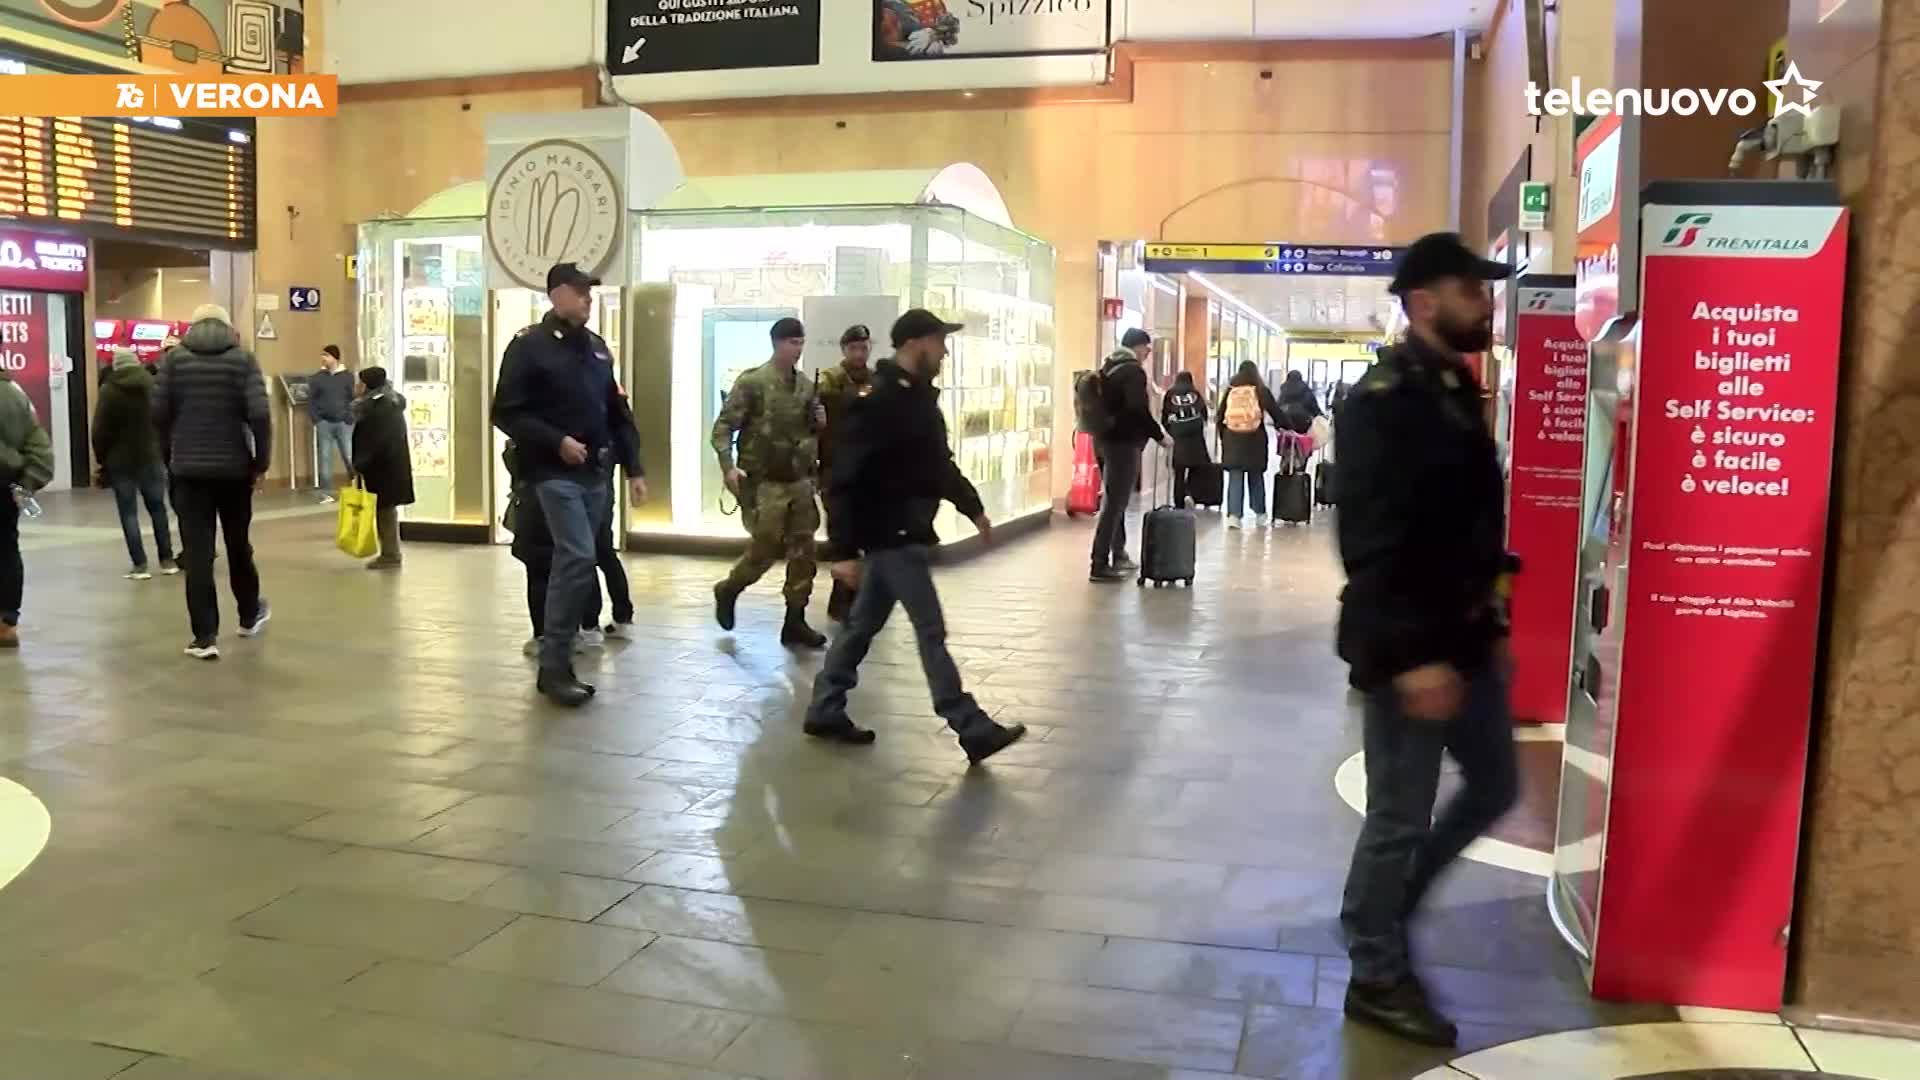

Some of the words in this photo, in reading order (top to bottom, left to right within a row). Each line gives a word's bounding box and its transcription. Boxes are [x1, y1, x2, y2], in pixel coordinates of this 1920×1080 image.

[630, 15, 667, 27] DELLA
[670, 9, 741, 24] TRADIZIONE
[743, 5, 799, 18] ITALIANA
[499, 161, 536, 218] IGINIO
[546, 154, 608, 215] MASSARI
[1706, 237, 1809, 250] TRENITALIA
[1692, 301, 1798, 325] Acquista
[1543, 337, 1586, 351] Acquis
[1712, 327, 1719, 345] i
[1727, 327, 1776, 347] tuoi
[1695, 350, 1791, 375] biglietti
[1528, 389, 1553, 400] Self
[1556, 391, 1585, 402] Serv
[1718, 376, 1764, 395] alle
[1665, 399, 1712, 418] Self
[1717, 401, 1815, 423] Service:
[1548, 430, 1583, 442] veloc
[1690, 425, 1706, 444] è
[1712, 426, 1786, 446] sicuro
[1692, 450, 1707, 468] è
[1714, 450, 1781, 472] facile
[1681, 473, 1696, 492] è
[1702, 475, 1789, 496] veloce!
